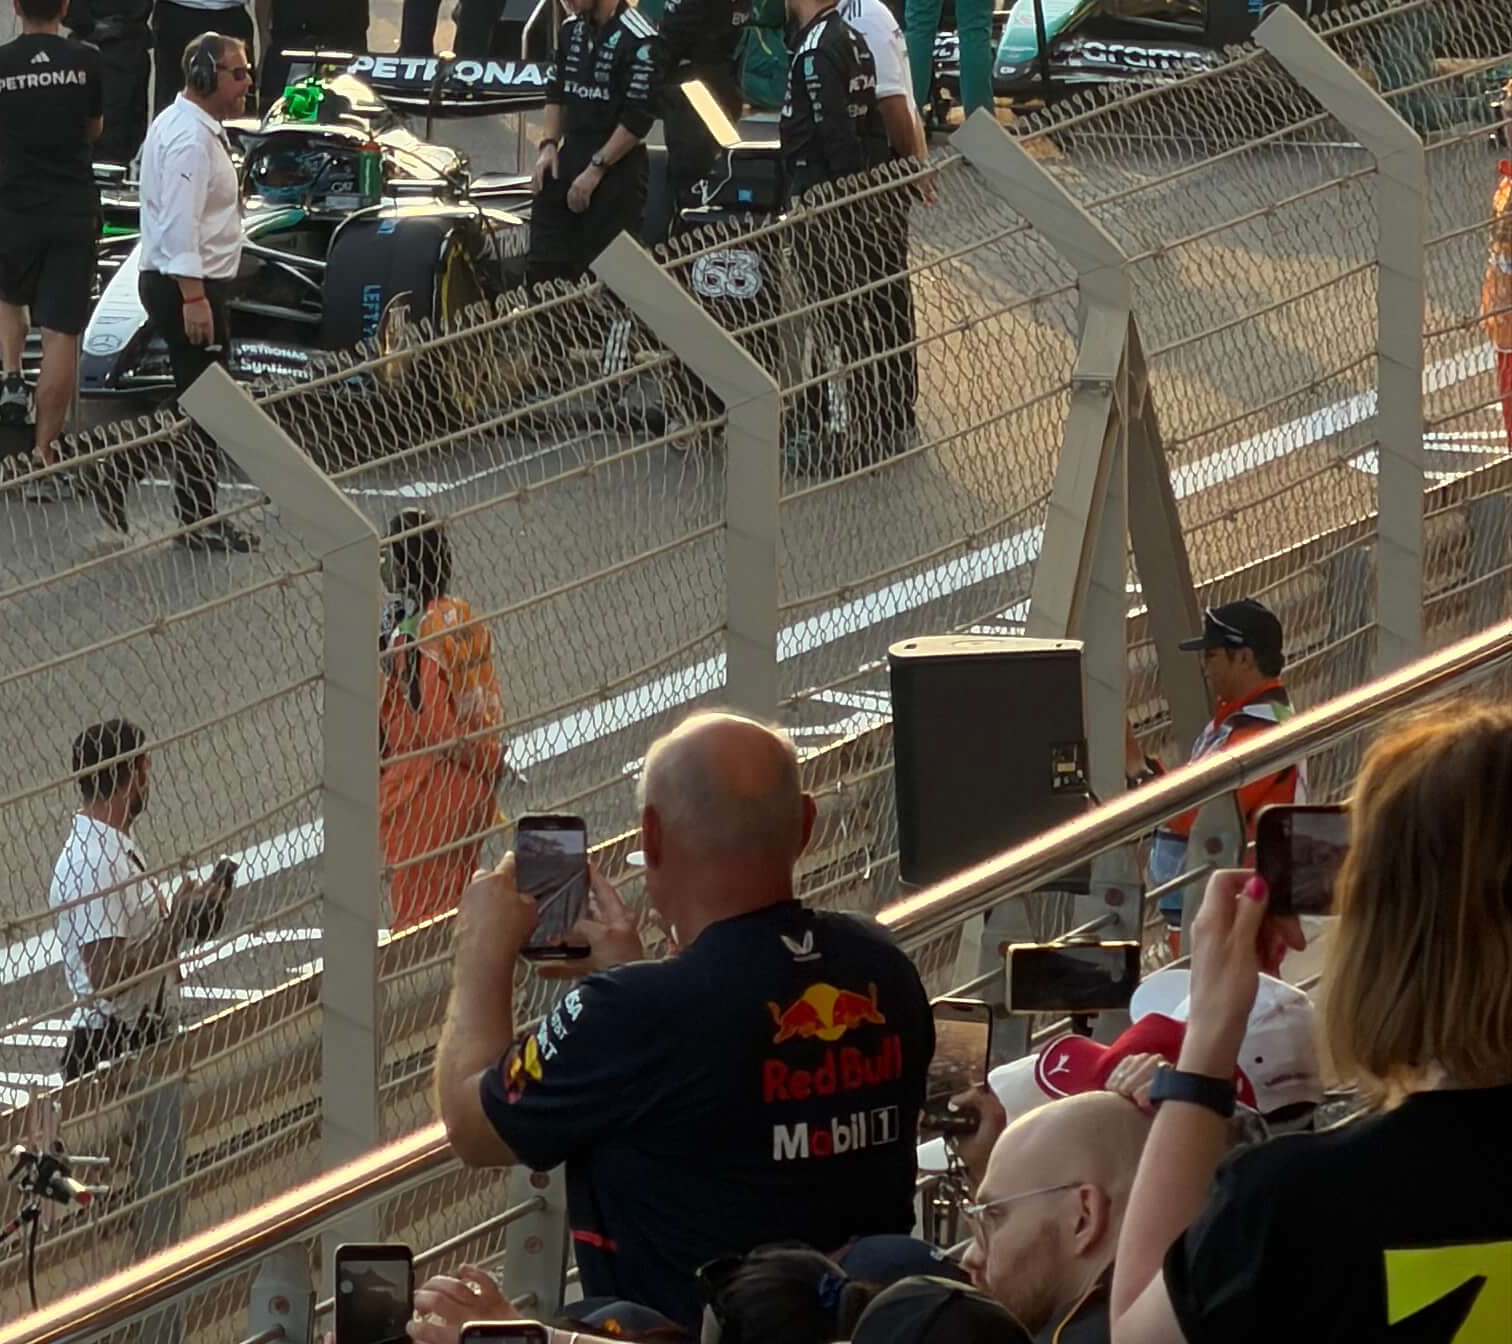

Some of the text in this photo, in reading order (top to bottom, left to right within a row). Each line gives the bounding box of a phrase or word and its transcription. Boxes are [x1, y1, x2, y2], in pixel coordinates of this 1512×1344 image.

[692, 249, 762, 299] 63
[361, 284, 382, 322] LEFT
[240, 343, 309, 361] PETRONAS
[763, 1036, 904, 1102] Red Bull
[773, 1112, 867, 1161] Mobil
